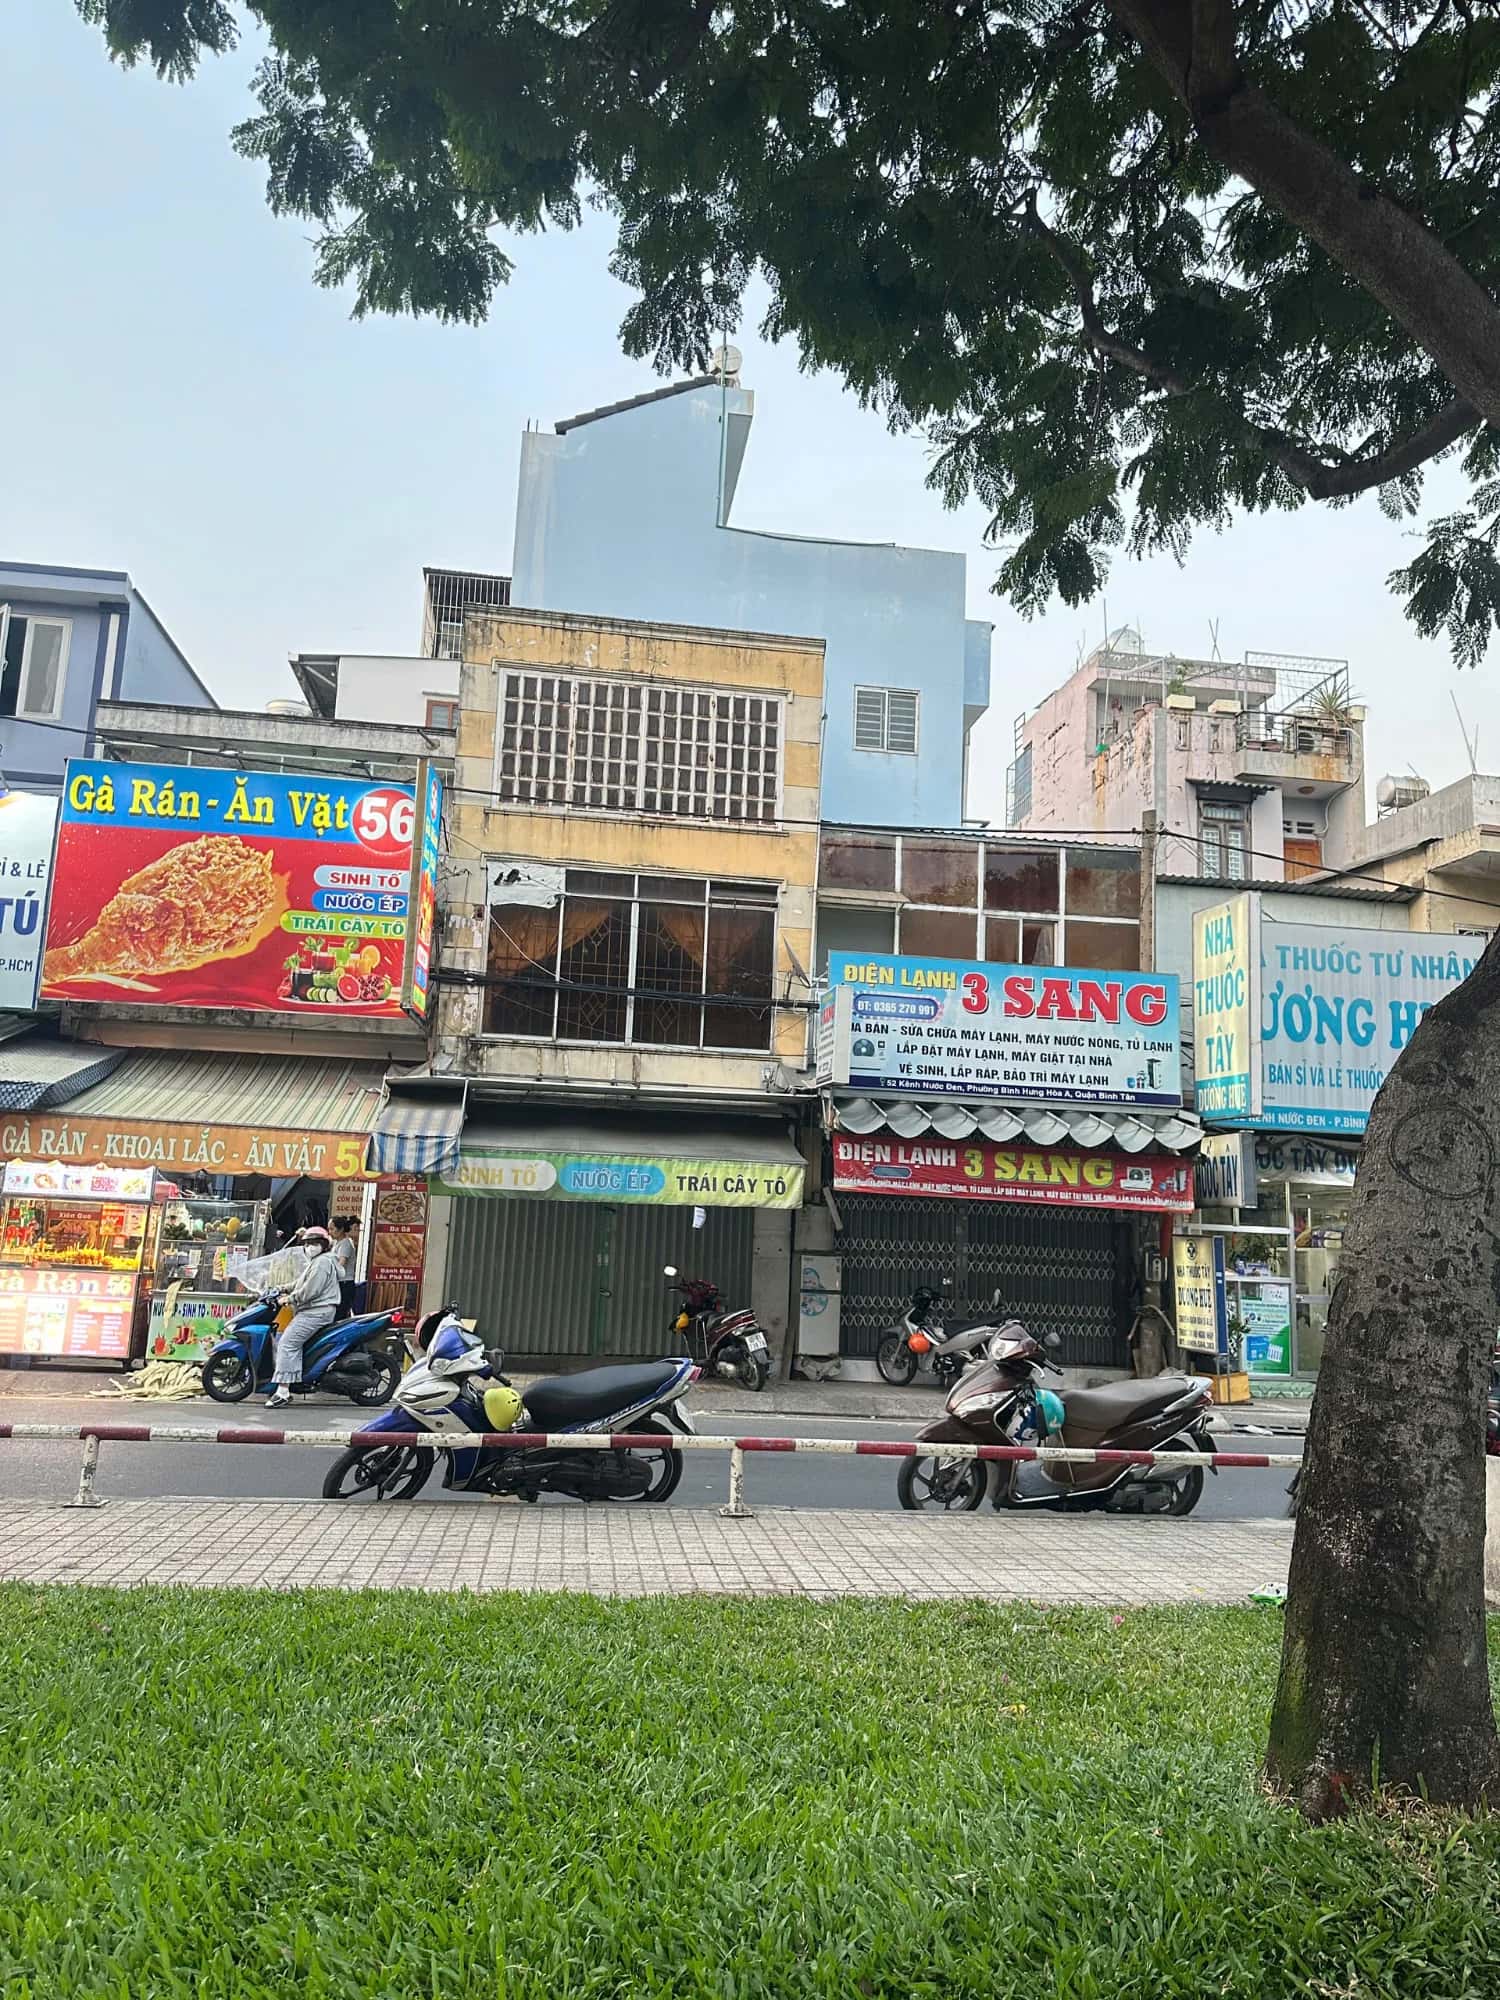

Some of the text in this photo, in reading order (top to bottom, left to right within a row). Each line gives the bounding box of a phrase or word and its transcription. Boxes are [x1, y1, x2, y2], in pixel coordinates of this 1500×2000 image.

[69, 775, 115, 812] Gà
[128, 778, 201, 819] Rán
[223, 775, 275, 824] Ăn
[288, 790, 349, 836] Vặt
[359, 796, 415, 843] 56
[10, 862, 21, 877] &
[27, 859, 46, 878] LẺ
[330, 872, 402, 888] SINH TỐ
[324, 893, 404, 912] NƯỚC ÉP
[292, 913, 405, 936] TRÁI CÂY TÔ
[1204, 908, 1235, 959] NHÀ
[1275, 941, 1362, 974] THUỐC
[1368, 949, 1404, 978] TƯ
[844, 964, 1168, 1026] ĐIỆN LẠNH 3 SANG
[1196, 956, 1245, 1017] THUỐC
[865, 1022, 889, 1034] BÁN
[900, 1023, 924, 1037] SỬA
[927, 1025, 957, 1040] CHỮA
[960, 1026, 986, 1041] MÁY
[989, 1031, 1022, 1044] LẠNH,
[1026, 1032, 1050, 1045] MÁY
[1054, 1034, 1085, 1047] NƯỚC
[1126, 1037, 1140, 1050] TỦ
[1143, 1040, 1173, 1054] LẠNH
[896, 1040, 1113, 1067] LẮP ĐẶT MÁY LẠNH, MÁY GIẶT TẠI NHÀ
[1206, 1026, 1235, 1075] TÂY
[916, 1064, 948, 1078] SINH,
[951, 1063, 972, 1078] LẮP
[1003, 1067, 1026, 1081] BẢO
[1050, 1070, 1076, 1084] MÁY
[1079, 1074, 1109, 1088] LẠNH
[1268, 1058, 1384, 1091] BÁN SỈ VÀ LẺ THUỐC
[1278, 1111, 1304, 1125] NƯỚC
[1306, 1114, 1326, 1126] ĐEN
[2, 1119, 31, 1154] GÀ
[38, 1122, 88, 1156] RÁN
[104, 1133, 177, 1161] KHOAI
[182, 1127, 225, 1164] LẮC
[244, 1135, 277, 1168] ĂN
[1290, 1142, 1328, 1173] TÂY
[457, 1163, 787, 1196] SINH TỐ NƯỚC ÉP TRÁI CÂY TÔ
[839, 1141, 1115, 1190] ĐIỆN LẠNH 3 SANG
[1220, 1143, 1238, 1198] TÂY
[36, 1269, 100, 1294] Rán
